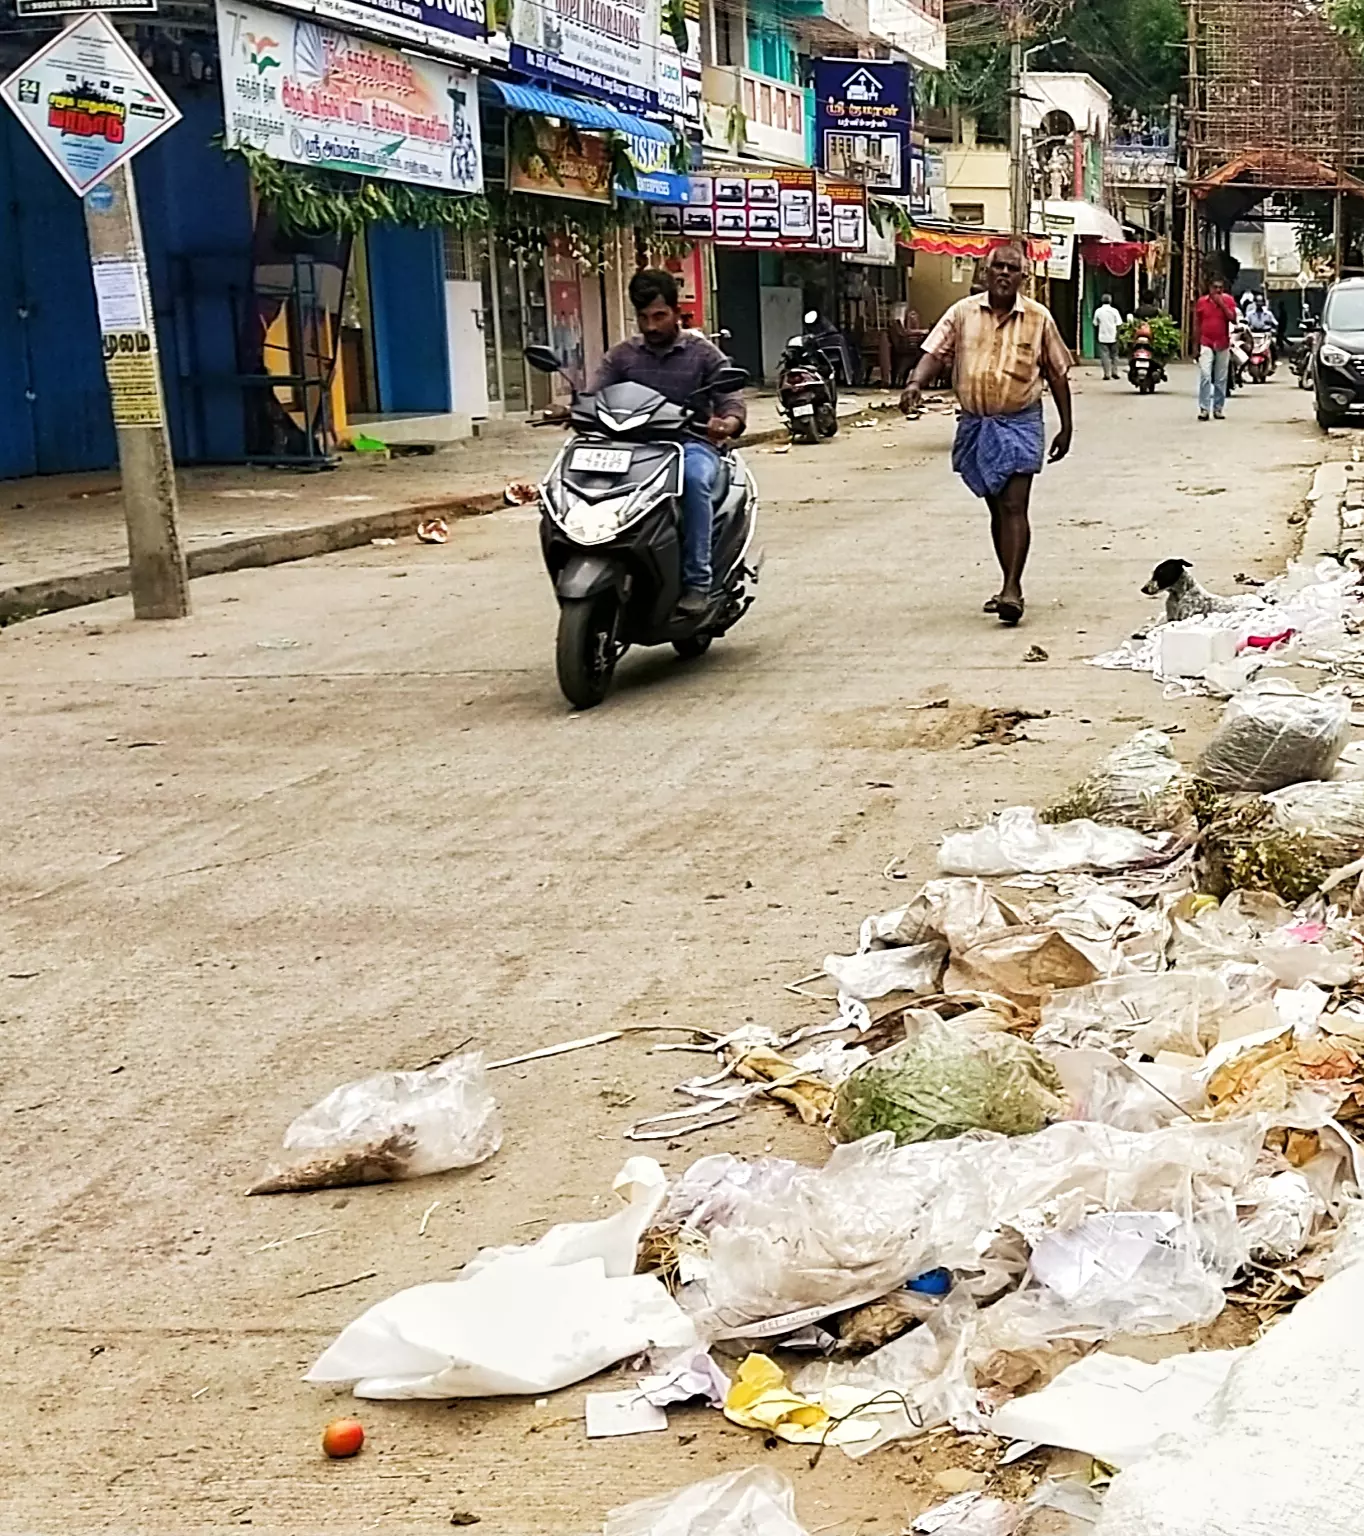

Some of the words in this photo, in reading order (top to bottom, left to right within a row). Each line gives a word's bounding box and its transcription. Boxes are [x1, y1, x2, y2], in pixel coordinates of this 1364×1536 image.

[424, 0, 486, 24] ORES
[20, 79, 38, 92] 24
[848, 103, 899, 118] குமரன்
[48, 107, 125, 143] மாநாடு
[323, 136, 360, 160] அம்மன்
